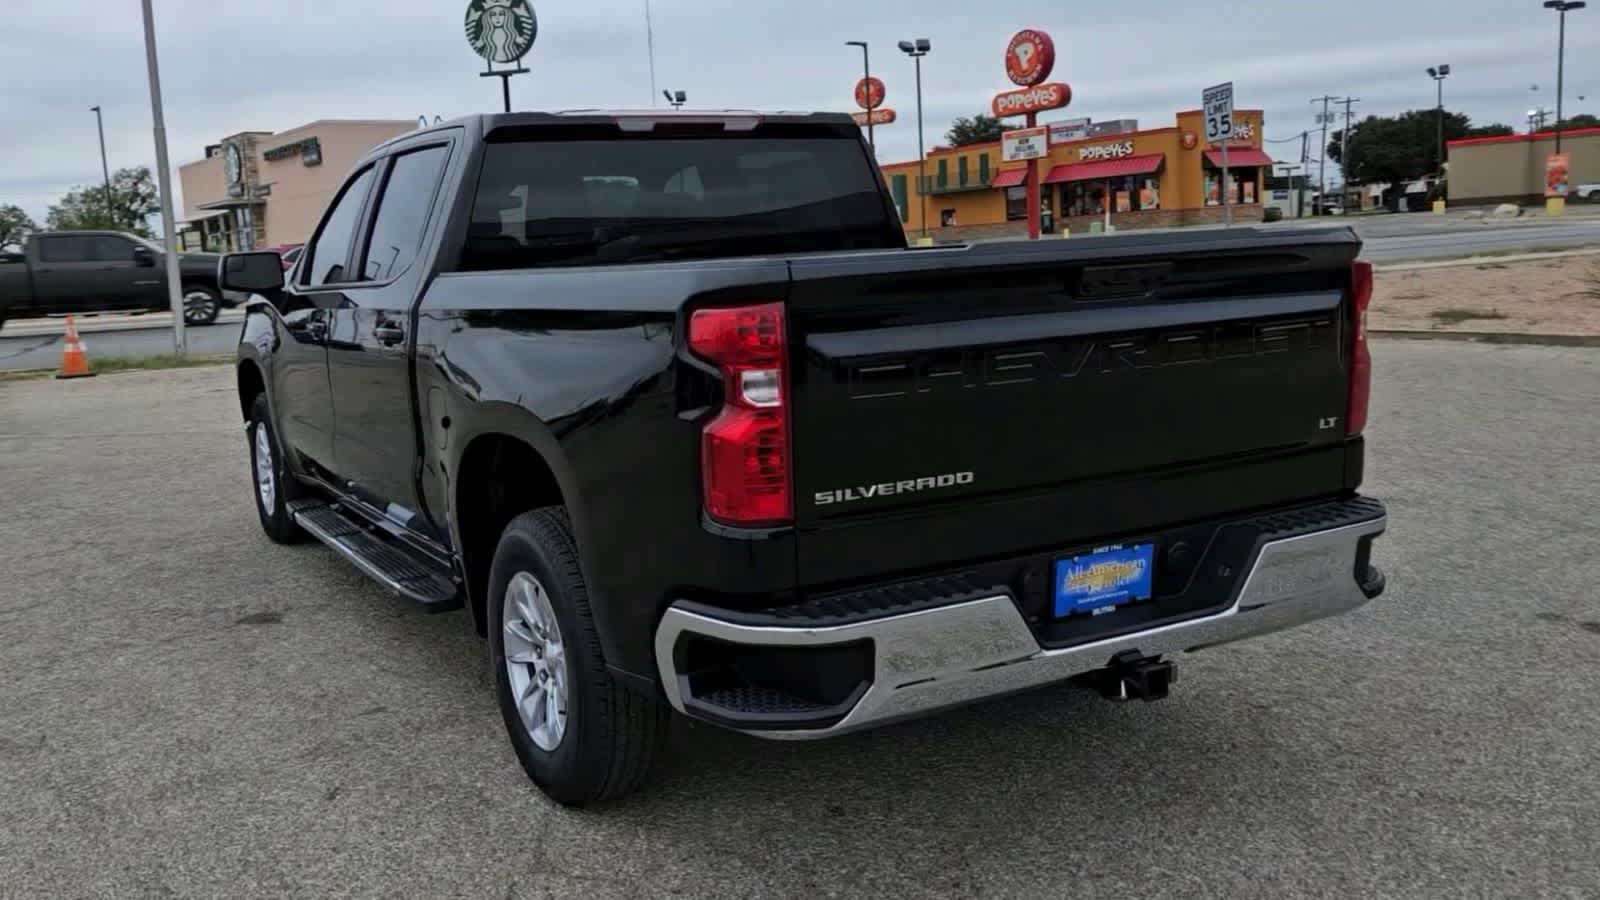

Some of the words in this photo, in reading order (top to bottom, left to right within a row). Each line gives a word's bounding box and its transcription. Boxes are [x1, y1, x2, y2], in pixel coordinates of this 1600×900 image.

[1204, 88, 1230, 104] SPEED
[1208, 101, 1228, 116] LIMIT
[1208, 114, 1231, 138] 35
[848, 320, 1334, 399] CHEVROLET
[1319, 416, 1337, 429] LT
[814, 471, 974, 505] SILVERADO
